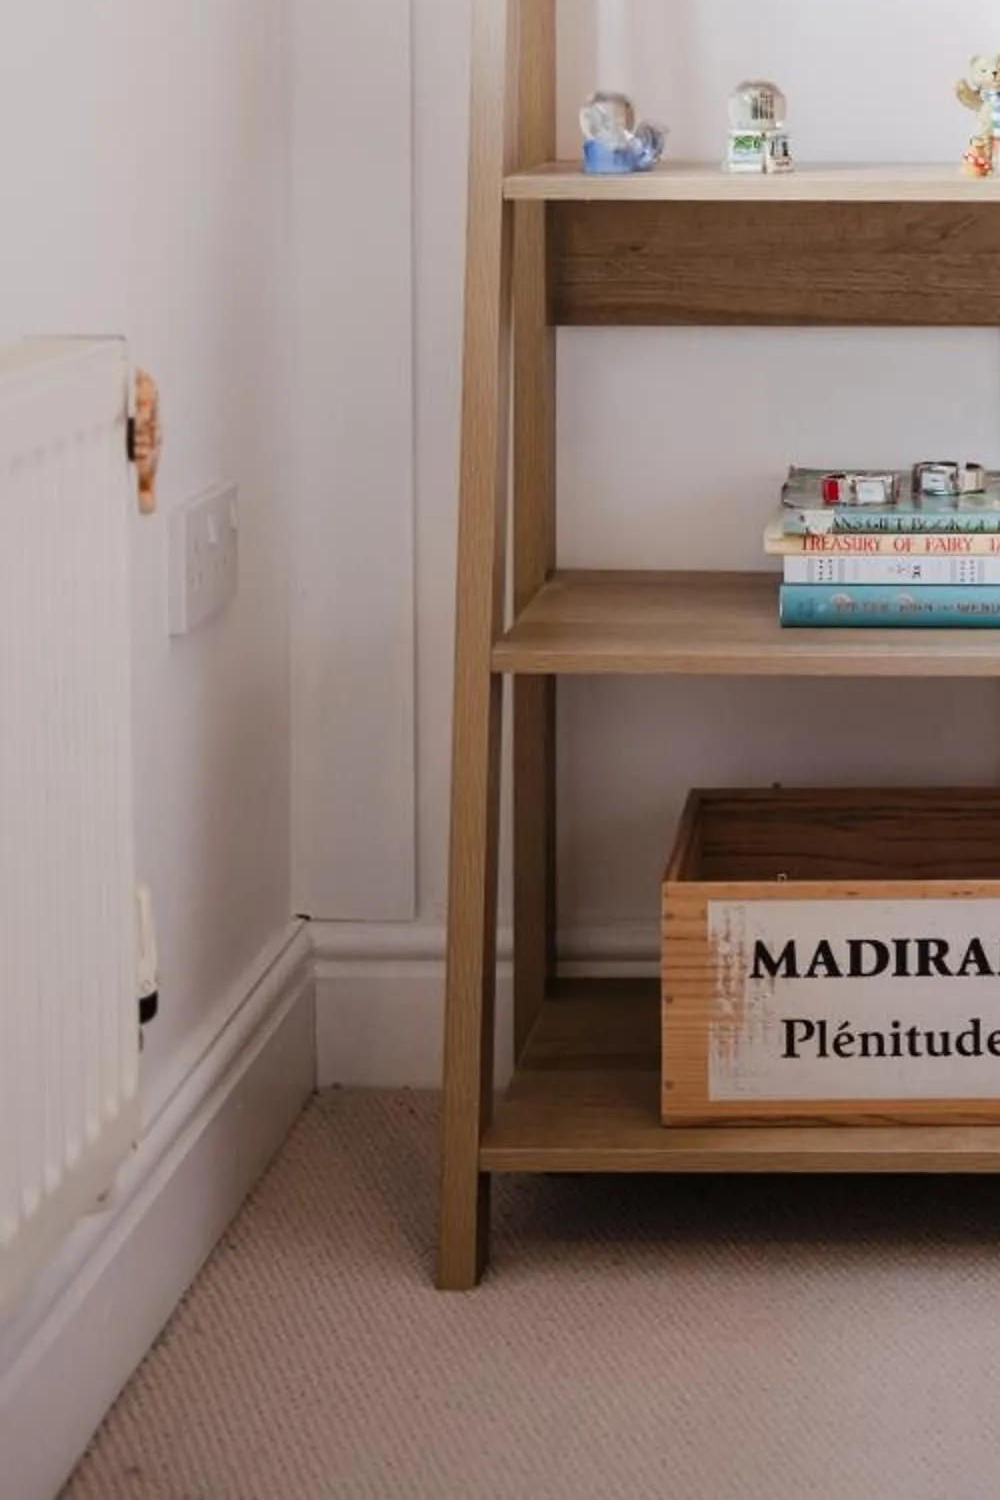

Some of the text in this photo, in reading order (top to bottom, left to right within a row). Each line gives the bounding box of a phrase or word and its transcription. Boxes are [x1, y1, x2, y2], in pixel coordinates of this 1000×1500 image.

[801, 535, 880, 551] TREASURY
[894, 537, 912, 551] OF
[925, 536, 973, 551] FAIRY
